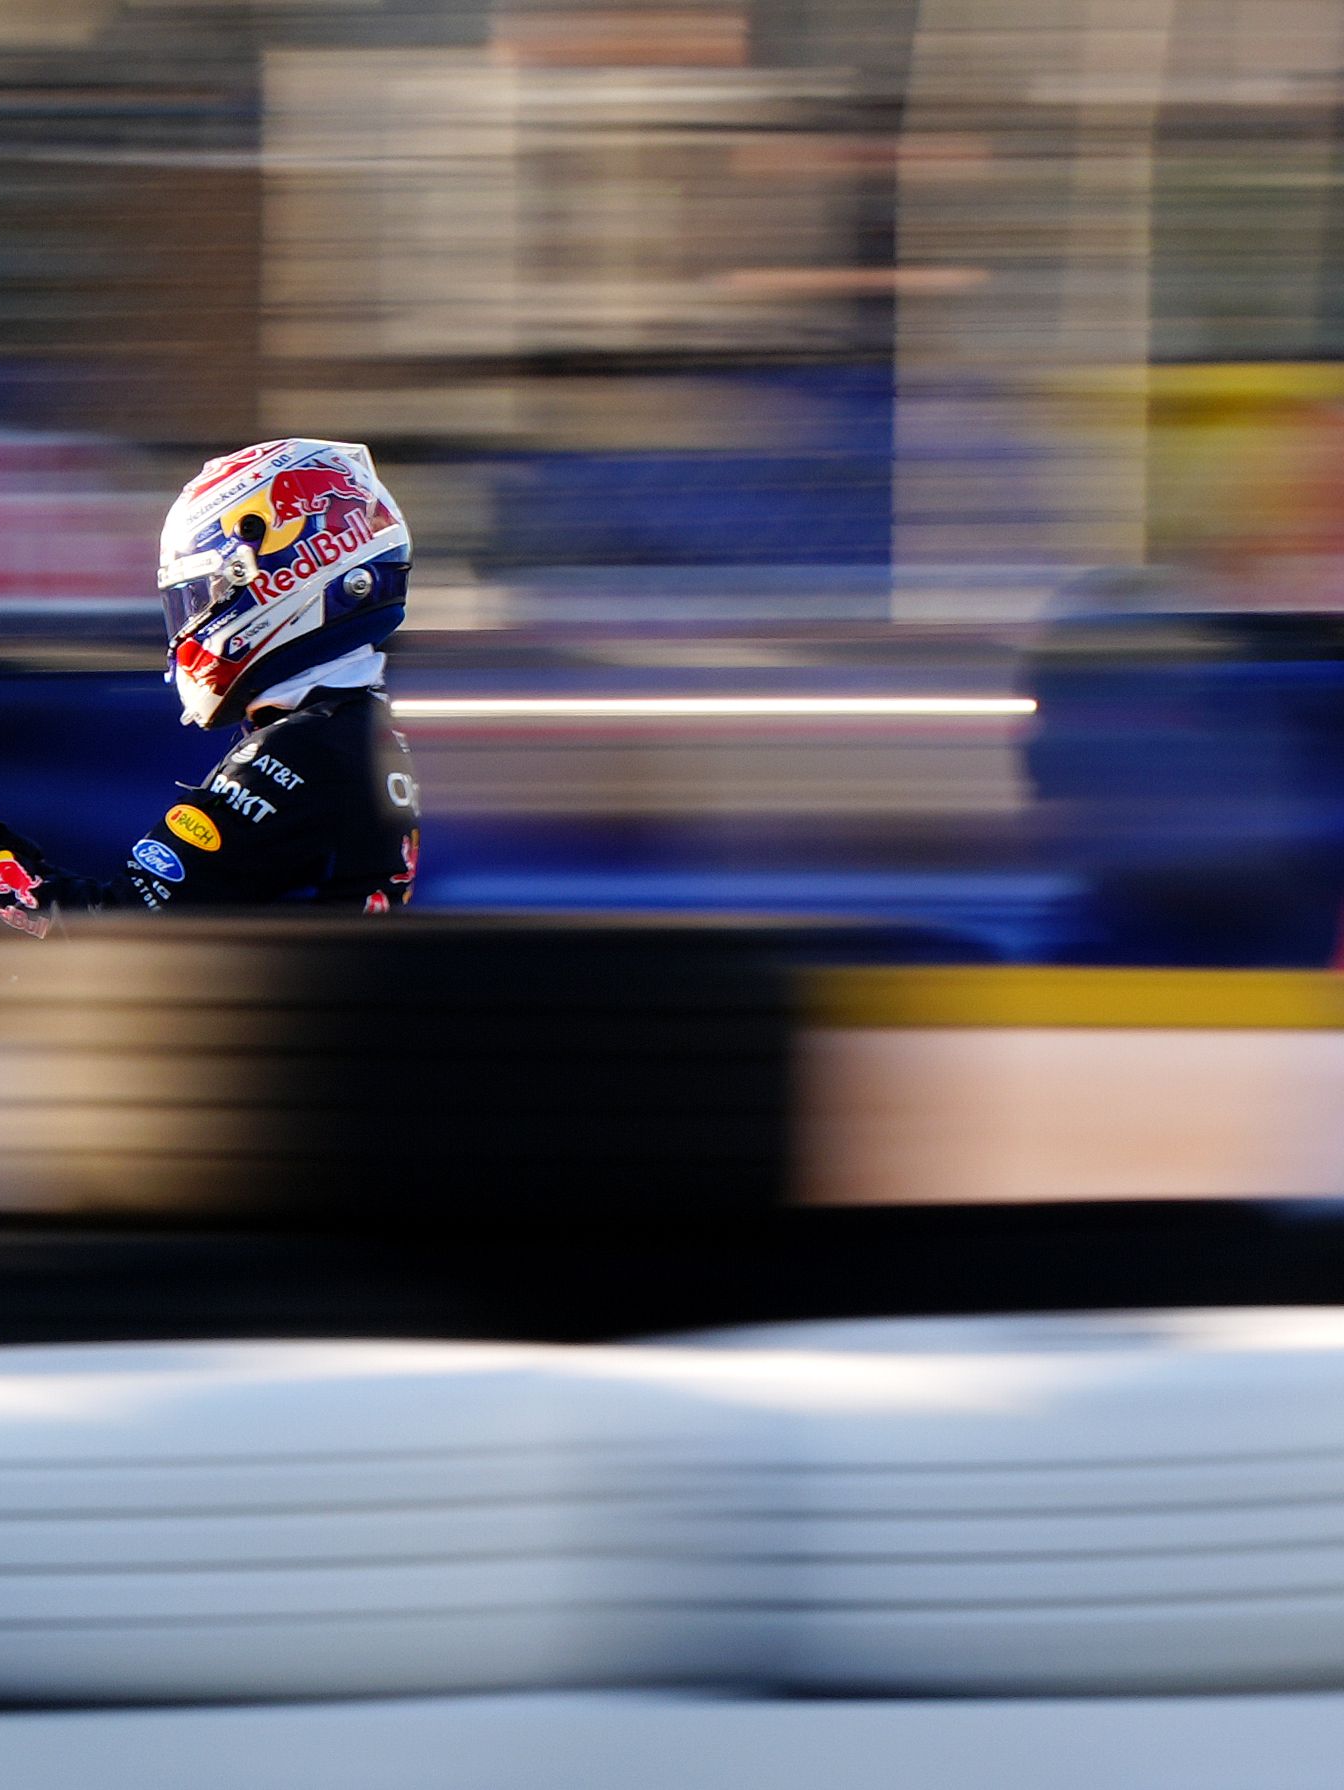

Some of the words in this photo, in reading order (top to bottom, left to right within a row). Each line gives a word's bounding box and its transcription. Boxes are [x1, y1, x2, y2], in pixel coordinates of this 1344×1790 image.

[249, 542, 318, 605] Red
[309, 510, 374, 567] Bull
[252, 754, 305, 790] AT&T
[175, 813, 214, 845] RAUCH
[139, 844, 175, 872] Ford
